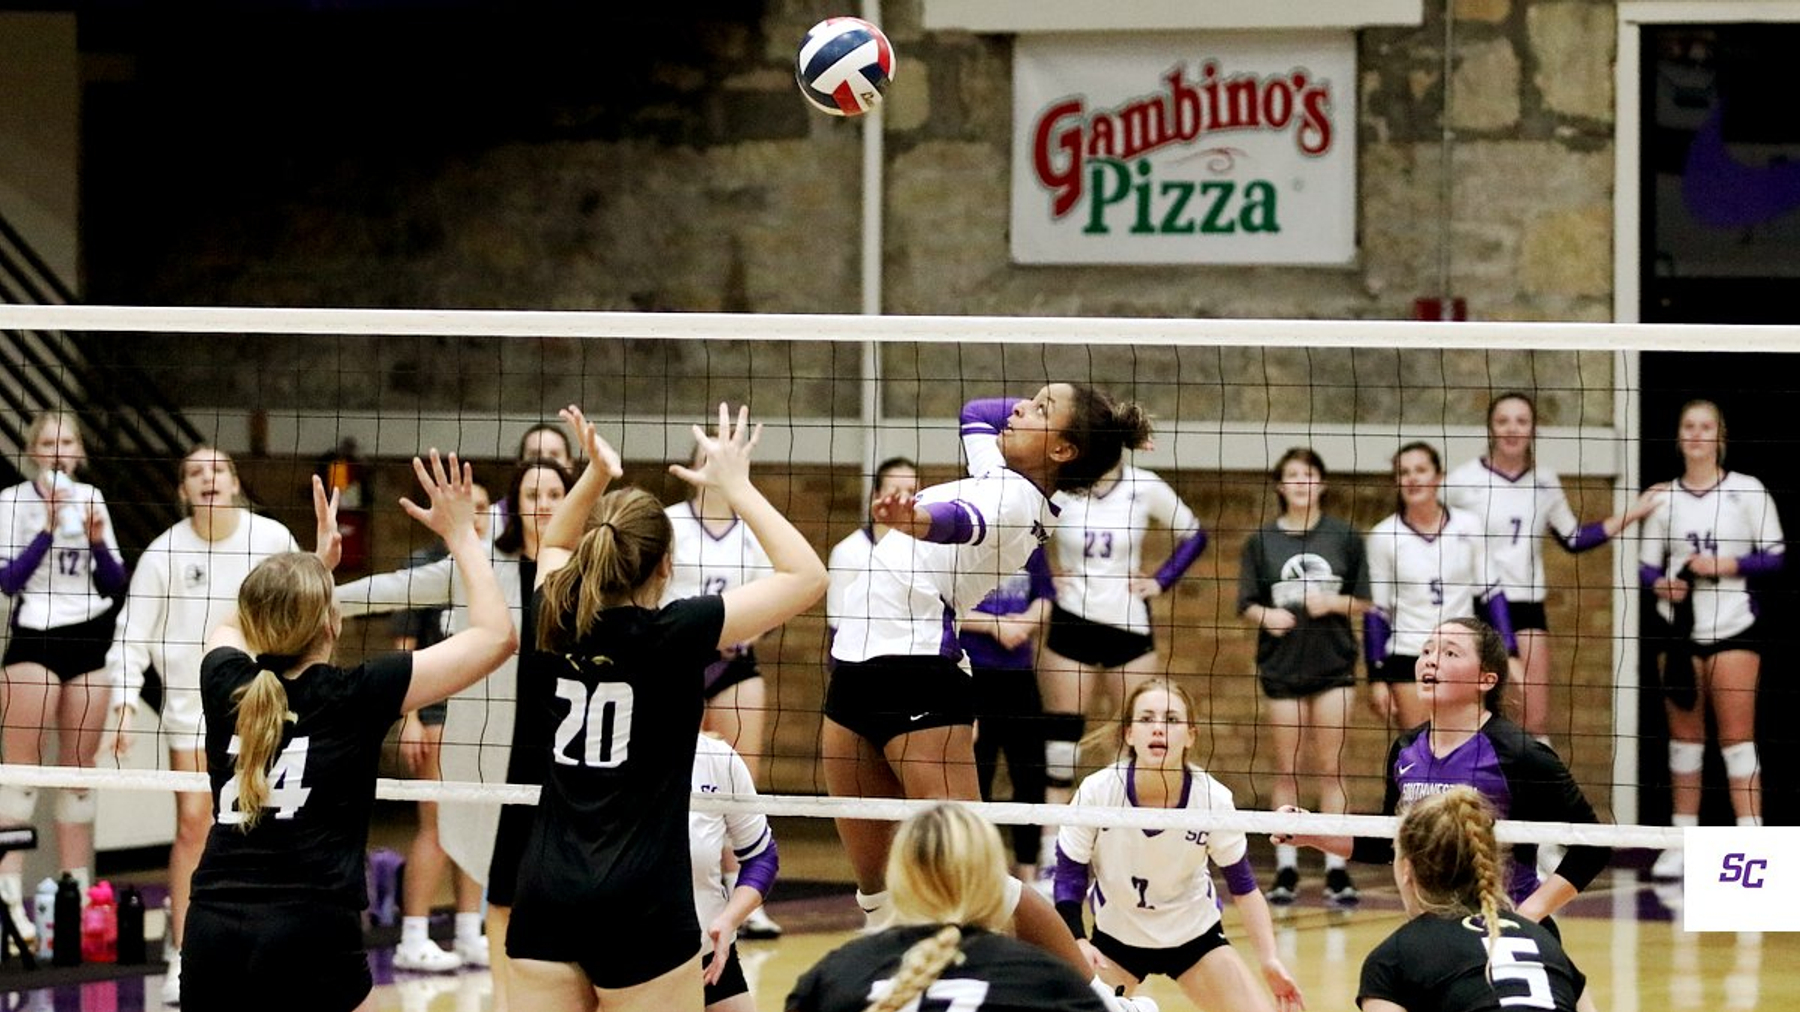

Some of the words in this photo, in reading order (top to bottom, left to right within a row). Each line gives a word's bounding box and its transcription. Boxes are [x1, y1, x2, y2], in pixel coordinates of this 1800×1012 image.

[1034, 61, 1332, 217] Gambino's
[1083, 157, 1280, 234] Pizza
[1084, 531, 1112, 558] 23
[1510, 518, 1521, 544] 7
[58, 551, 80, 577] 12
[1430, 578, 1443, 605] 5
[553, 677, 634, 768] 20
[1185, 829, 1209, 846] SC
[1481, 937, 1557, 1010] 5
